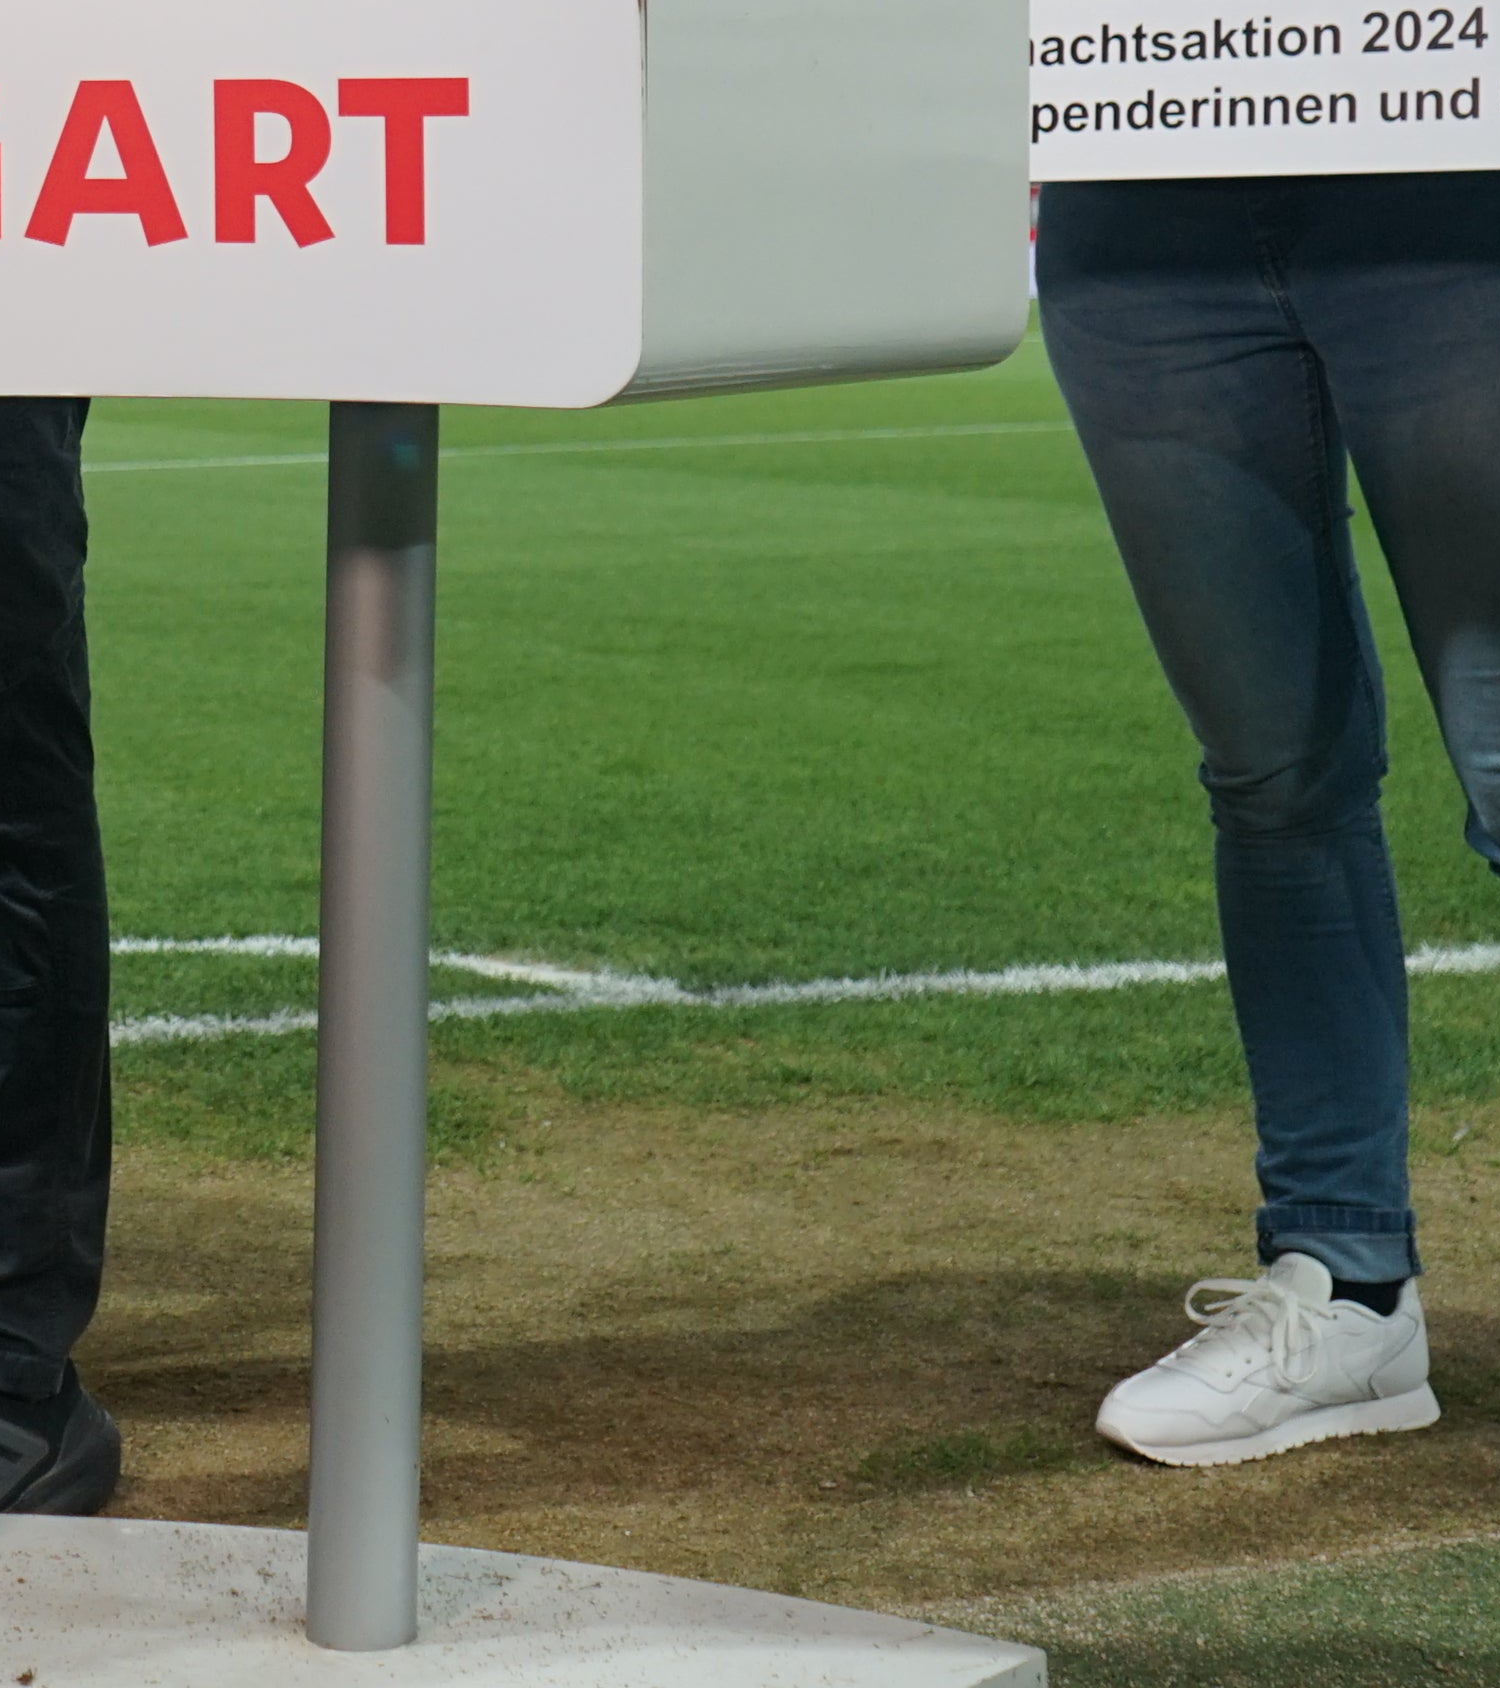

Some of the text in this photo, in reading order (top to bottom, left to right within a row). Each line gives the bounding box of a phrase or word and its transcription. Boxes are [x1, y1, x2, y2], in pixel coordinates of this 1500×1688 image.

[1029, 6, 1489, 69] achtsaktion 2024
[1031, 85, 1358, 143] penderinnen
[1379, 76, 1482, 122] und
